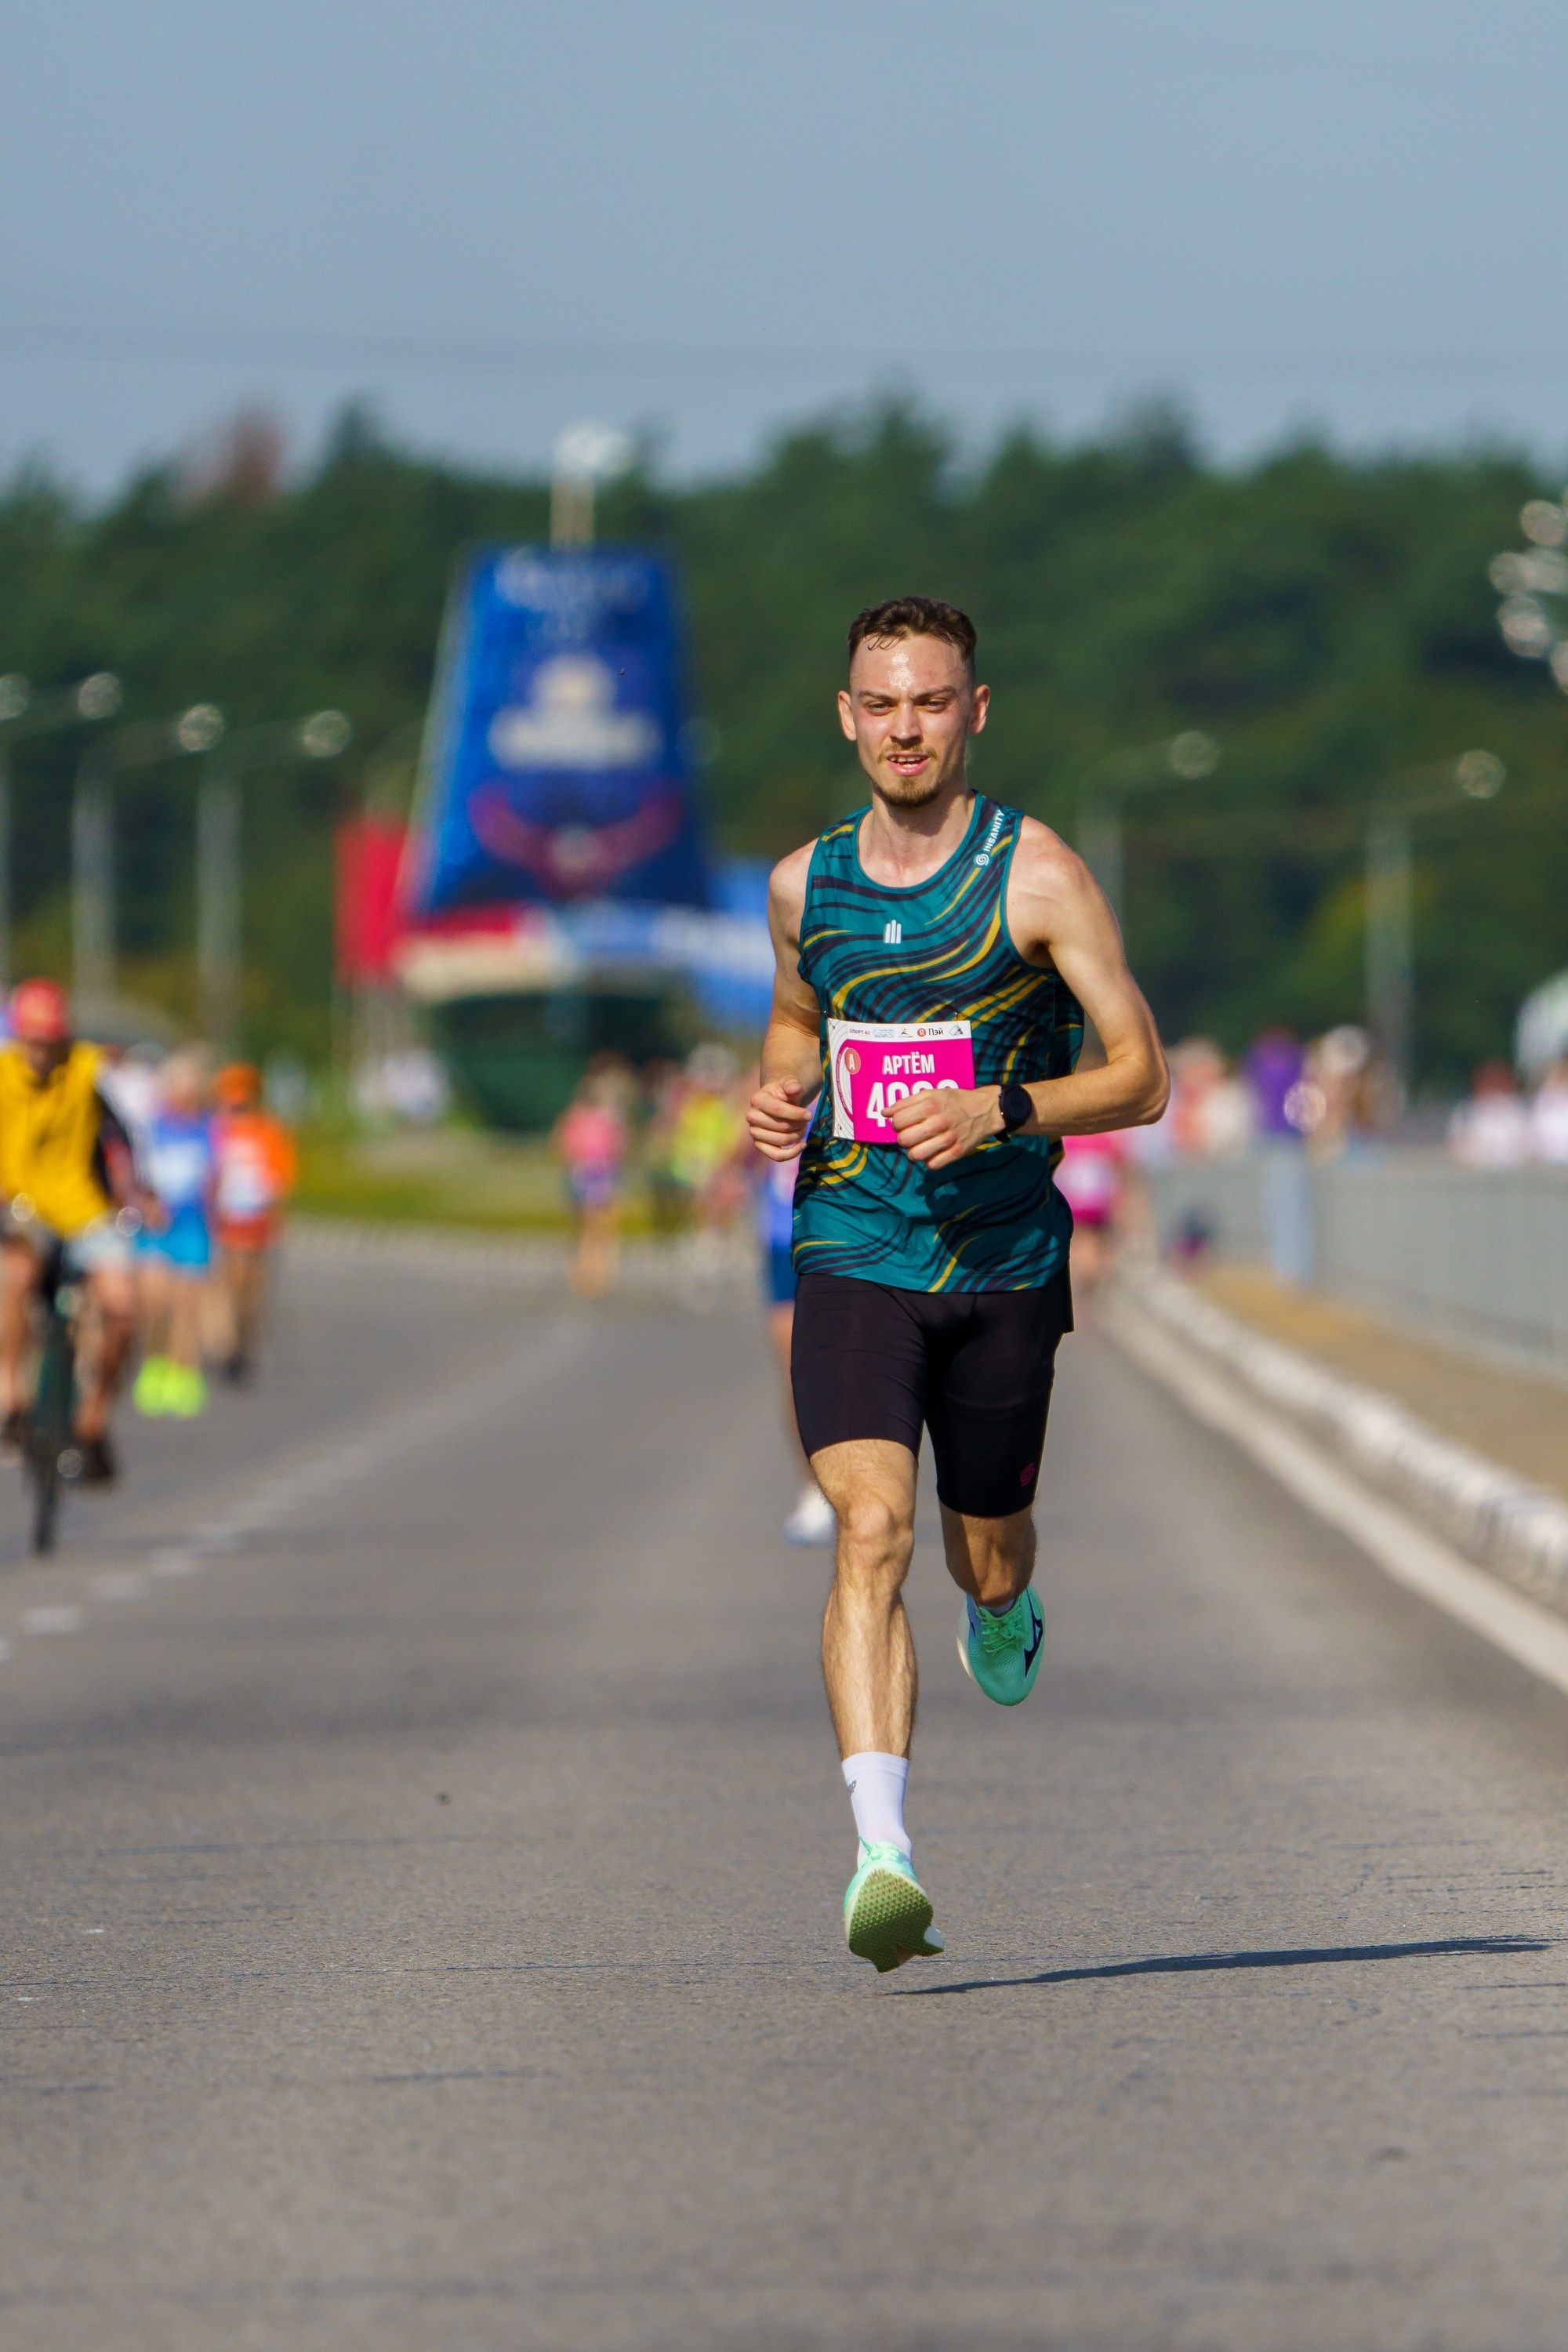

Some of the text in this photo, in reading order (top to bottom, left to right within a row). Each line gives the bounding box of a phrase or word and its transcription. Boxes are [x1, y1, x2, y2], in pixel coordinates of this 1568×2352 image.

[983, 808, 1005, 852] INSANITY
[928, 1027, 944, 1036] Пэй
[883, 1051, 935, 1075] АРТЁМ
